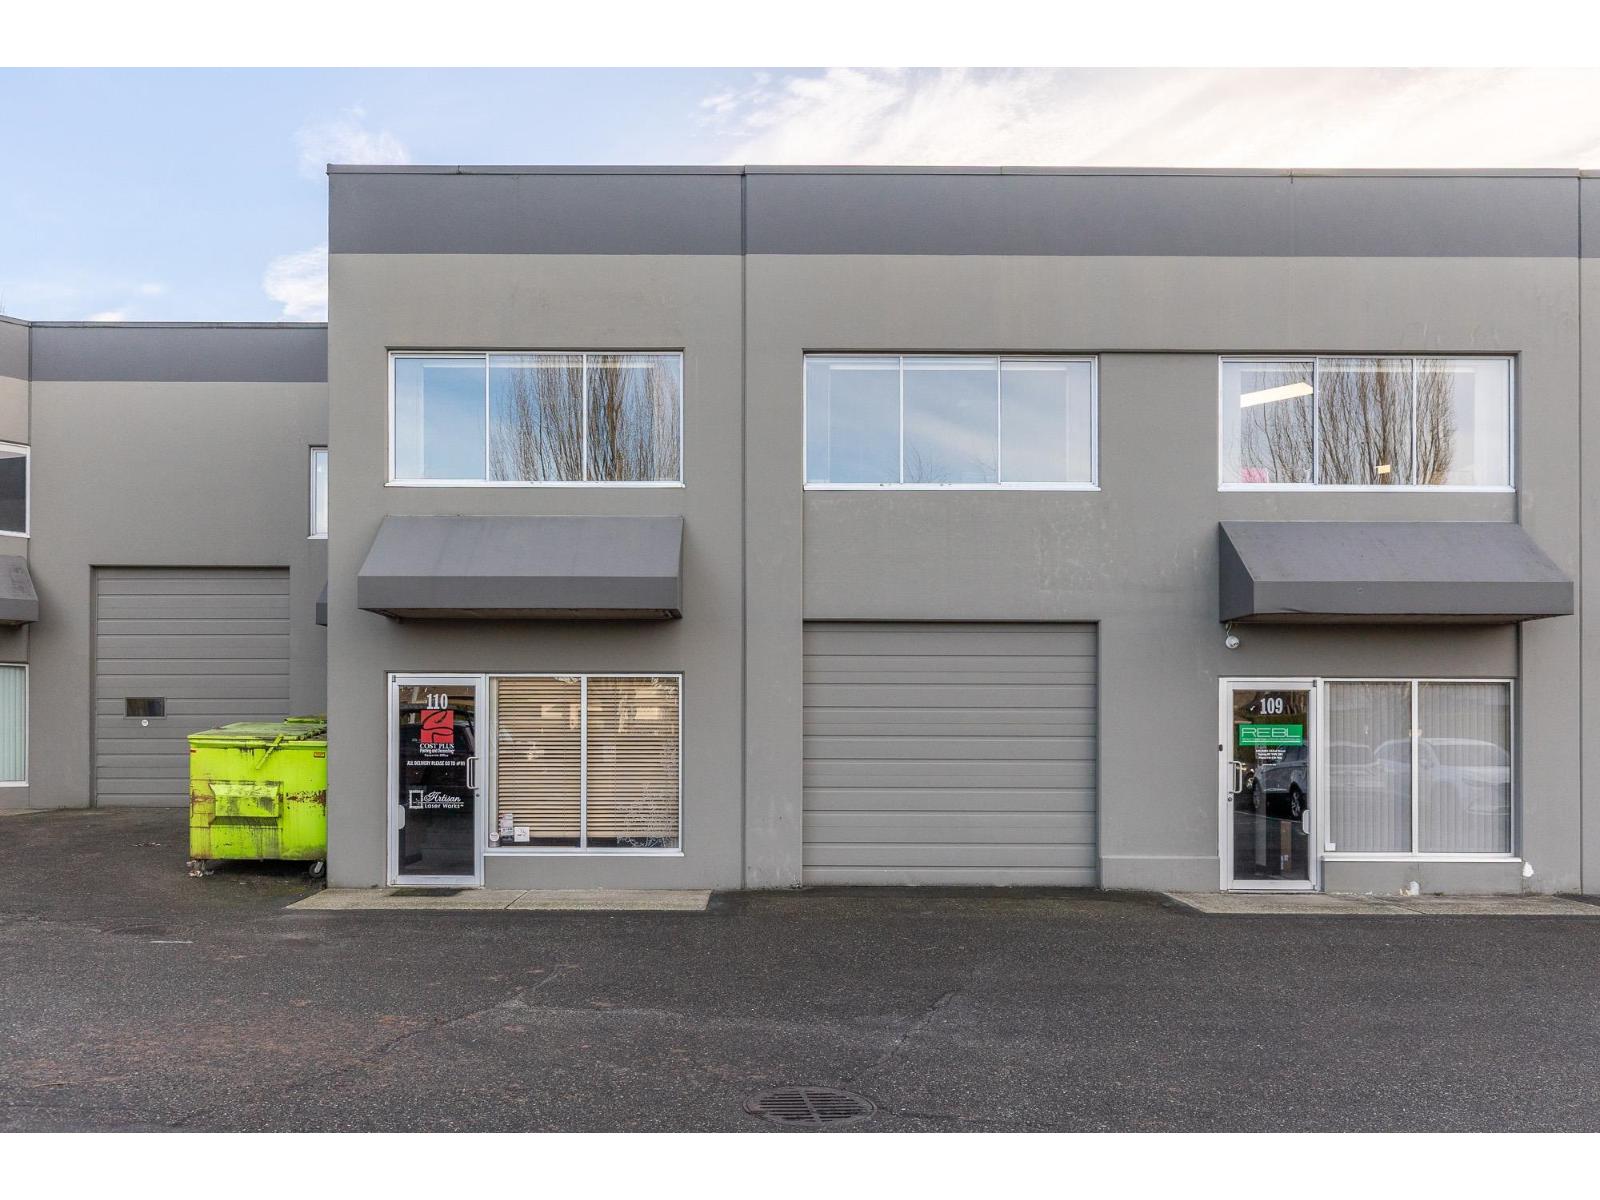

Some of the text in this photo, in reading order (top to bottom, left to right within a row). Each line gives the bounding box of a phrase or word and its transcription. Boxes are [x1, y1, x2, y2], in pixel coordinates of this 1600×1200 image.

[426, 693, 448, 710] 110
[1260, 697, 1284, 715] 109
[1241, 727, 1301, 738] REBL
[424, 791, 461, 802] Artisan
